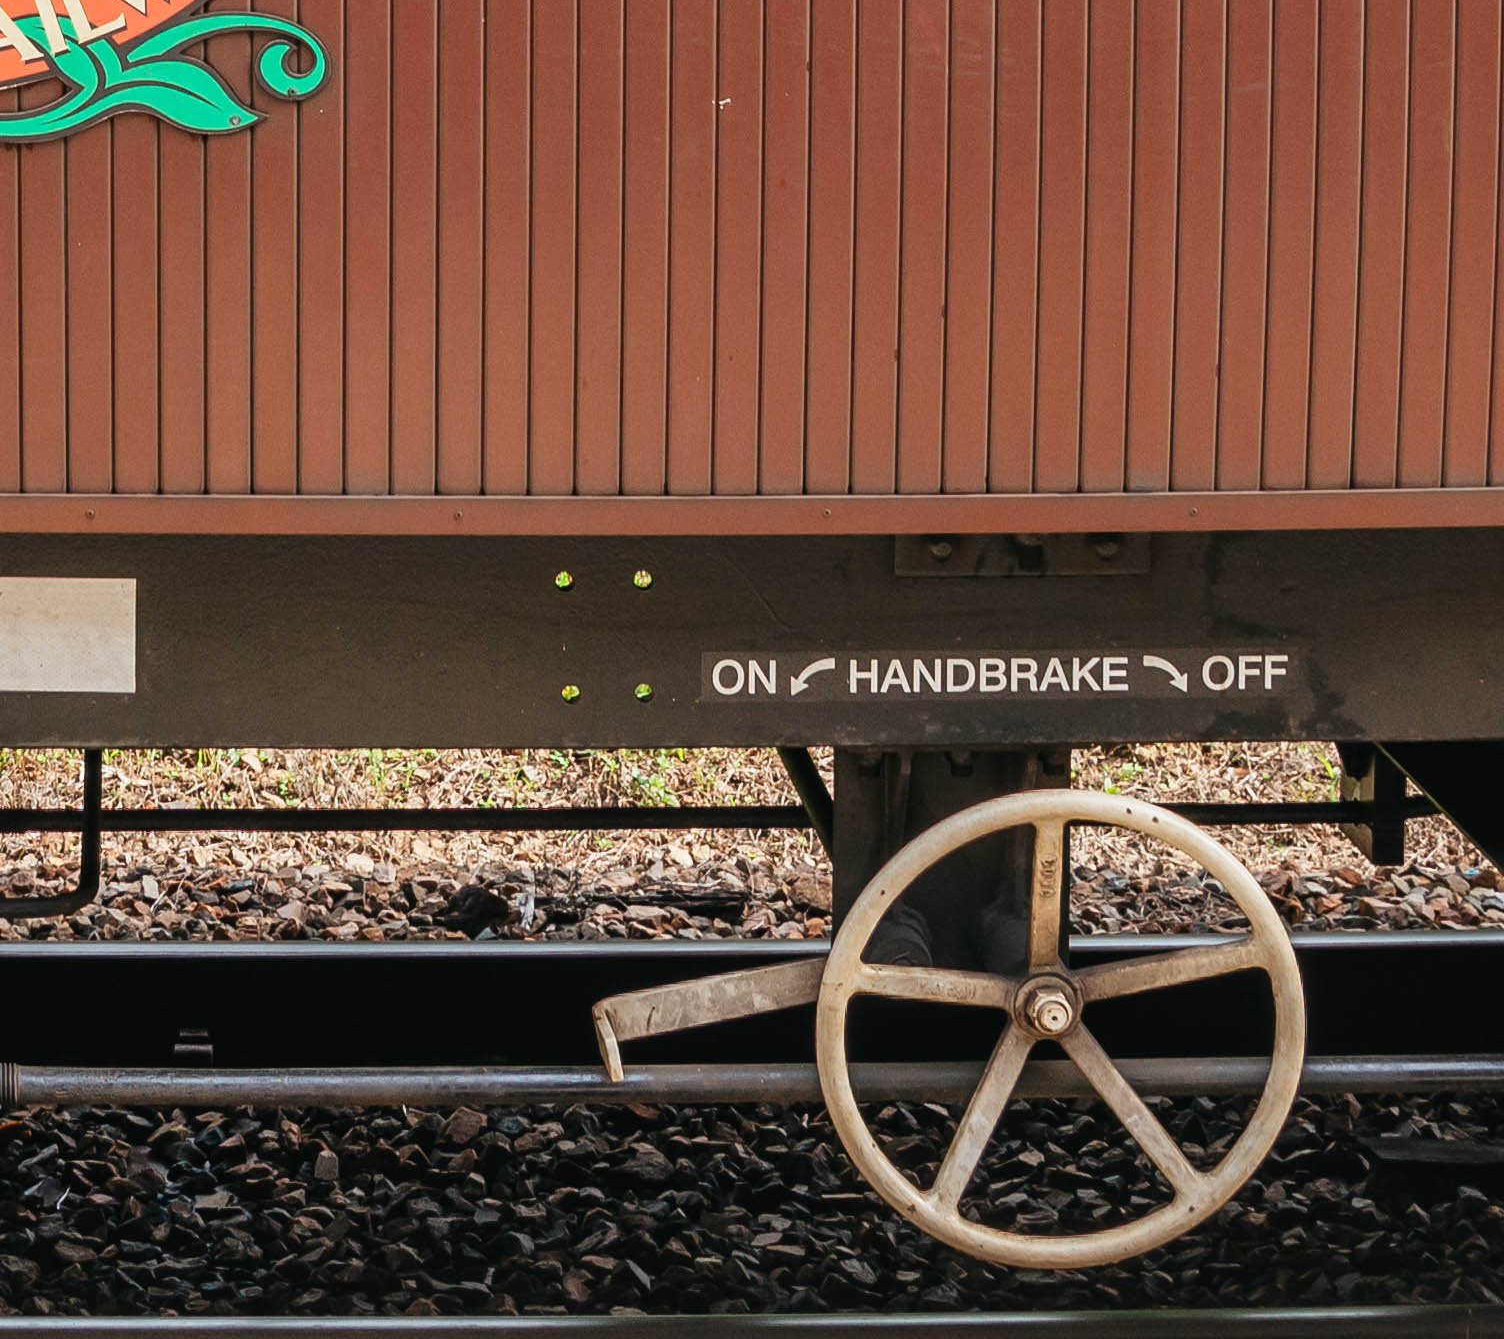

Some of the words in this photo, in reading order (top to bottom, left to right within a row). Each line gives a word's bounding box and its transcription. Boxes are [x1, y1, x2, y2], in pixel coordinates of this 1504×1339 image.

[711, 658, 778, 695] ON
[849, 656, 1130, 694] HANDBRAKE
[1201, 654, 1289, 690] OFF
